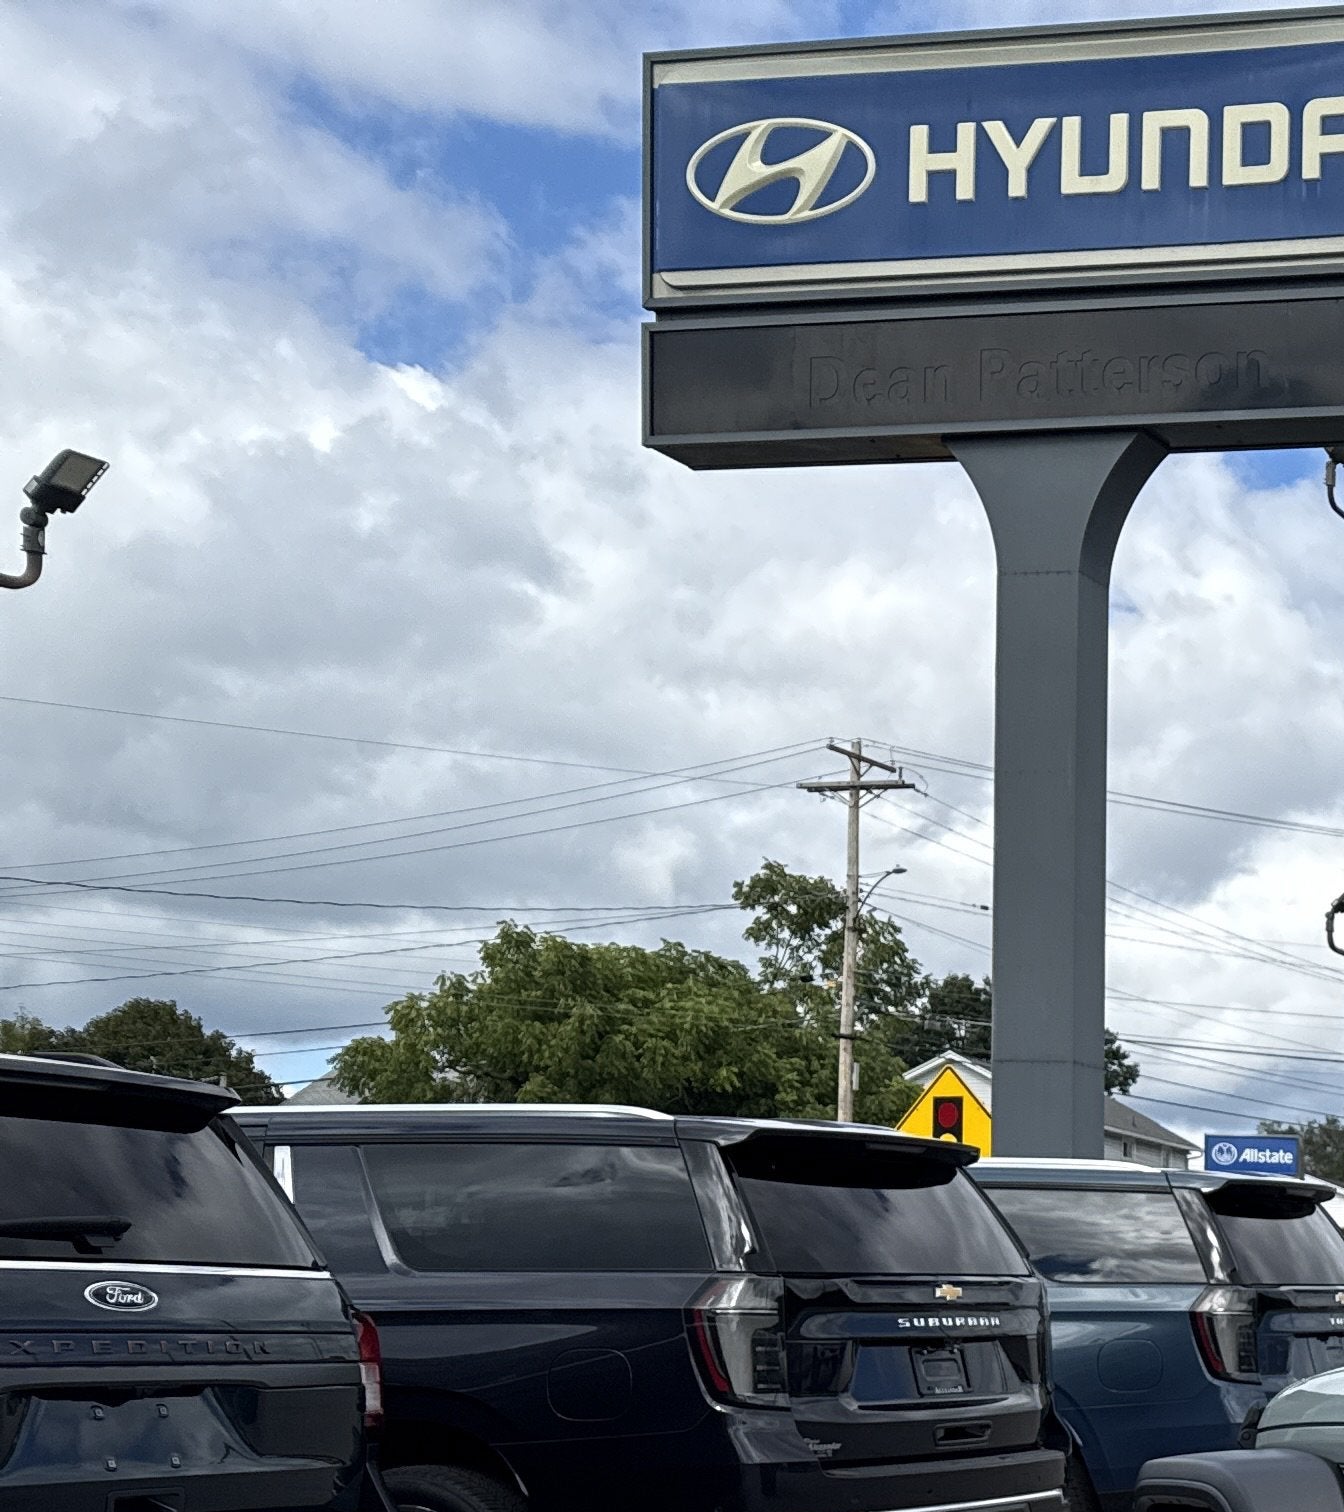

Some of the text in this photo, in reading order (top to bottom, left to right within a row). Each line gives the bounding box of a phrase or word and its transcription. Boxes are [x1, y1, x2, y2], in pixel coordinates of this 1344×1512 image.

[808, 346, 1271, 408] Dean Patterson
[1239, 1148, 1294, 1164] Allstate
[105, 1286, 144, 1305] Ford
[897, 1316, 1000, 1328] SUBURBAN
